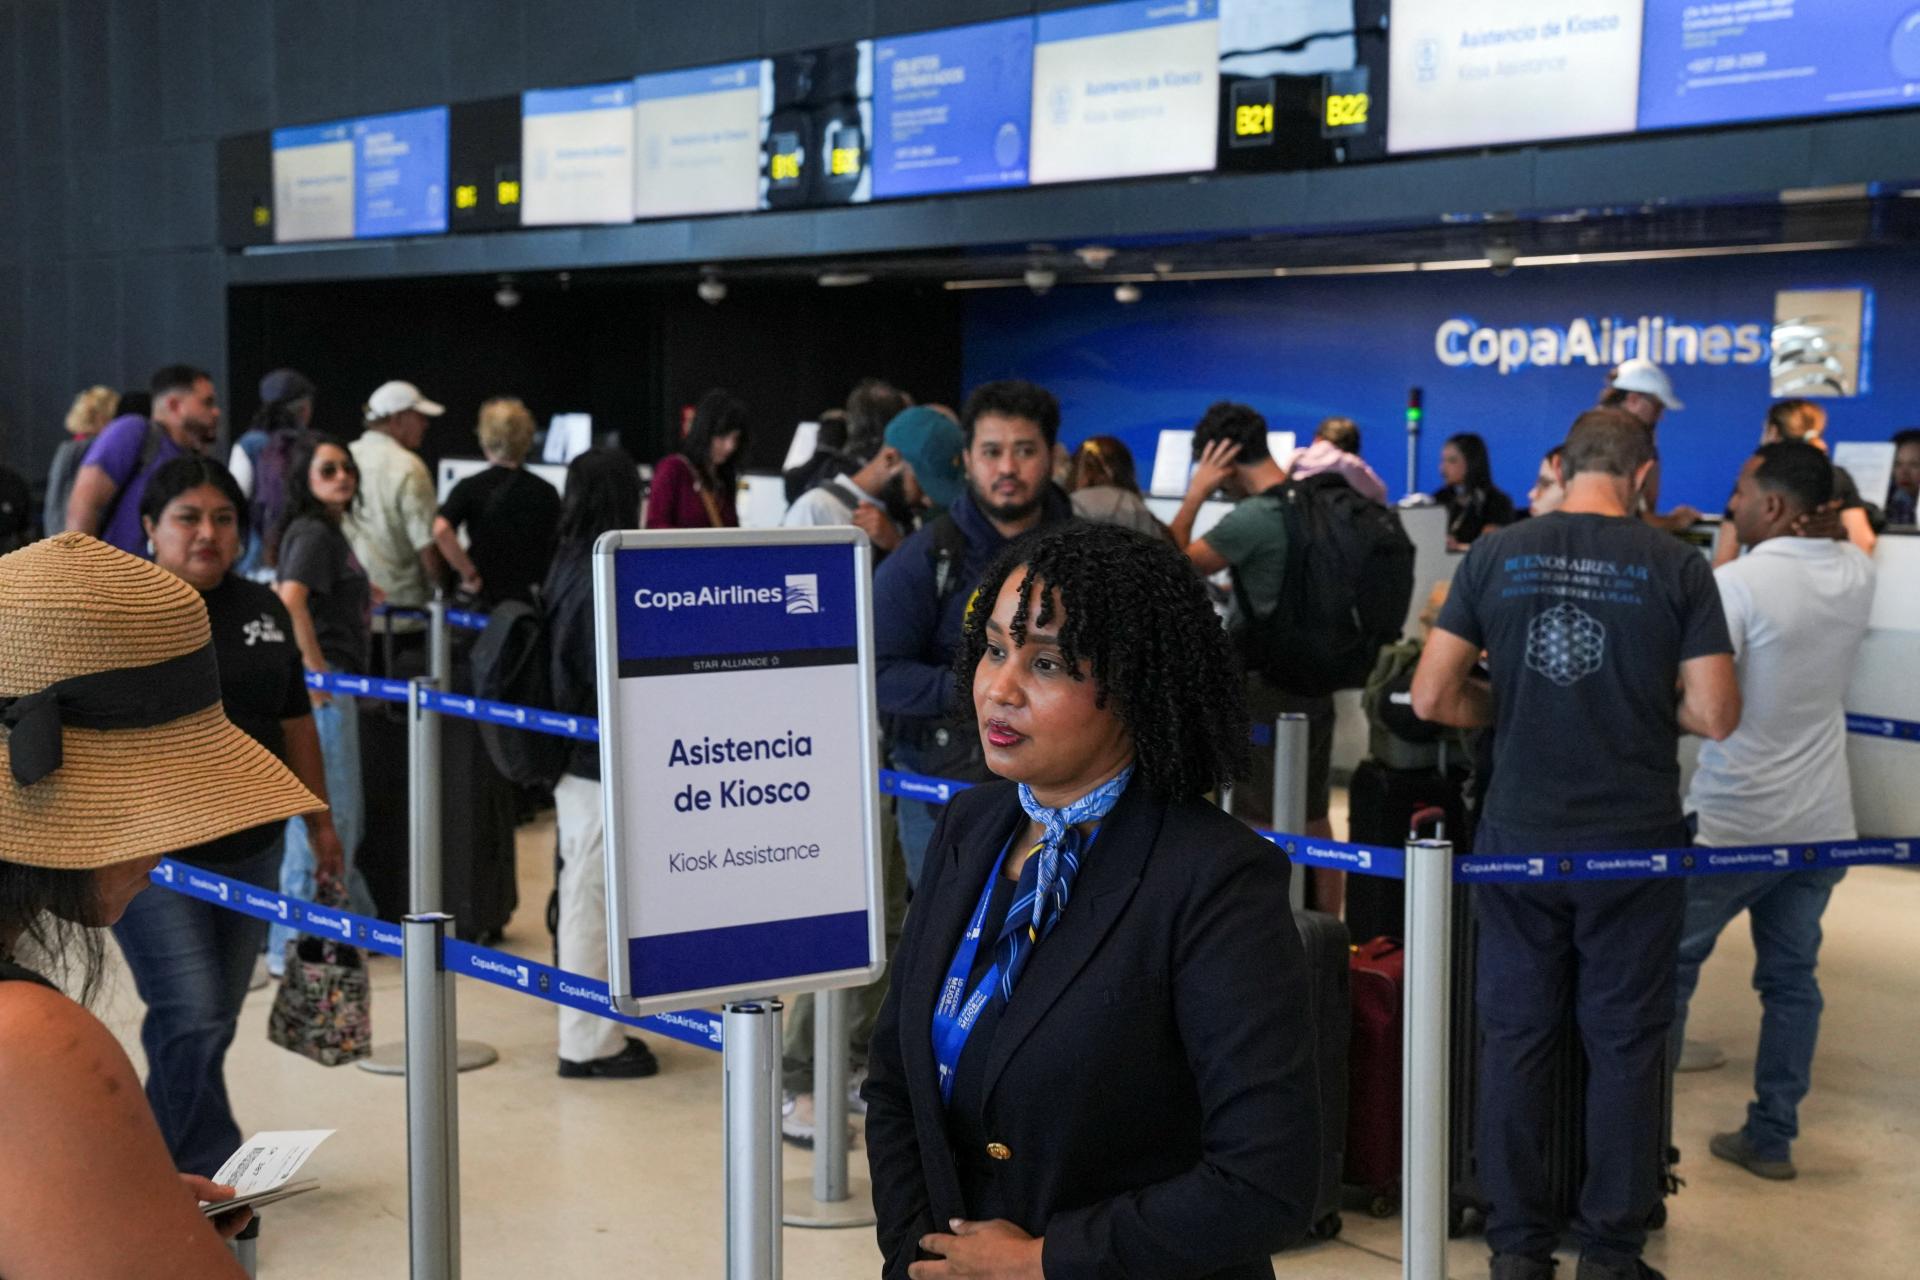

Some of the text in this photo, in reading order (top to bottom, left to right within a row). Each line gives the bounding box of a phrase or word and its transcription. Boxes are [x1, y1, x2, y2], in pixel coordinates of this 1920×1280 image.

[1236, 103, 1274, 136] B21
[1326, 93, 1369, 126] B22
[1435, 316, 1763, 374] CopaAirlines
[634, 585, 783, 611] CopaAirlines
[693, 656, 768, 671] STAR ALLIANCE
[668, 730, 812, 767] Asistencia
[674, 779, 811, 812] de Kiosco
[669, 843, 820, 873] Kiosk Assistance
[1461, 862, 1527, 874] CopaAirlines
[1586, 858, 1651, 870] CopaAirlines
[471, 955, 518, 978] CopaAirlines
[559, 981, 610, 1005] CopaAirlines
